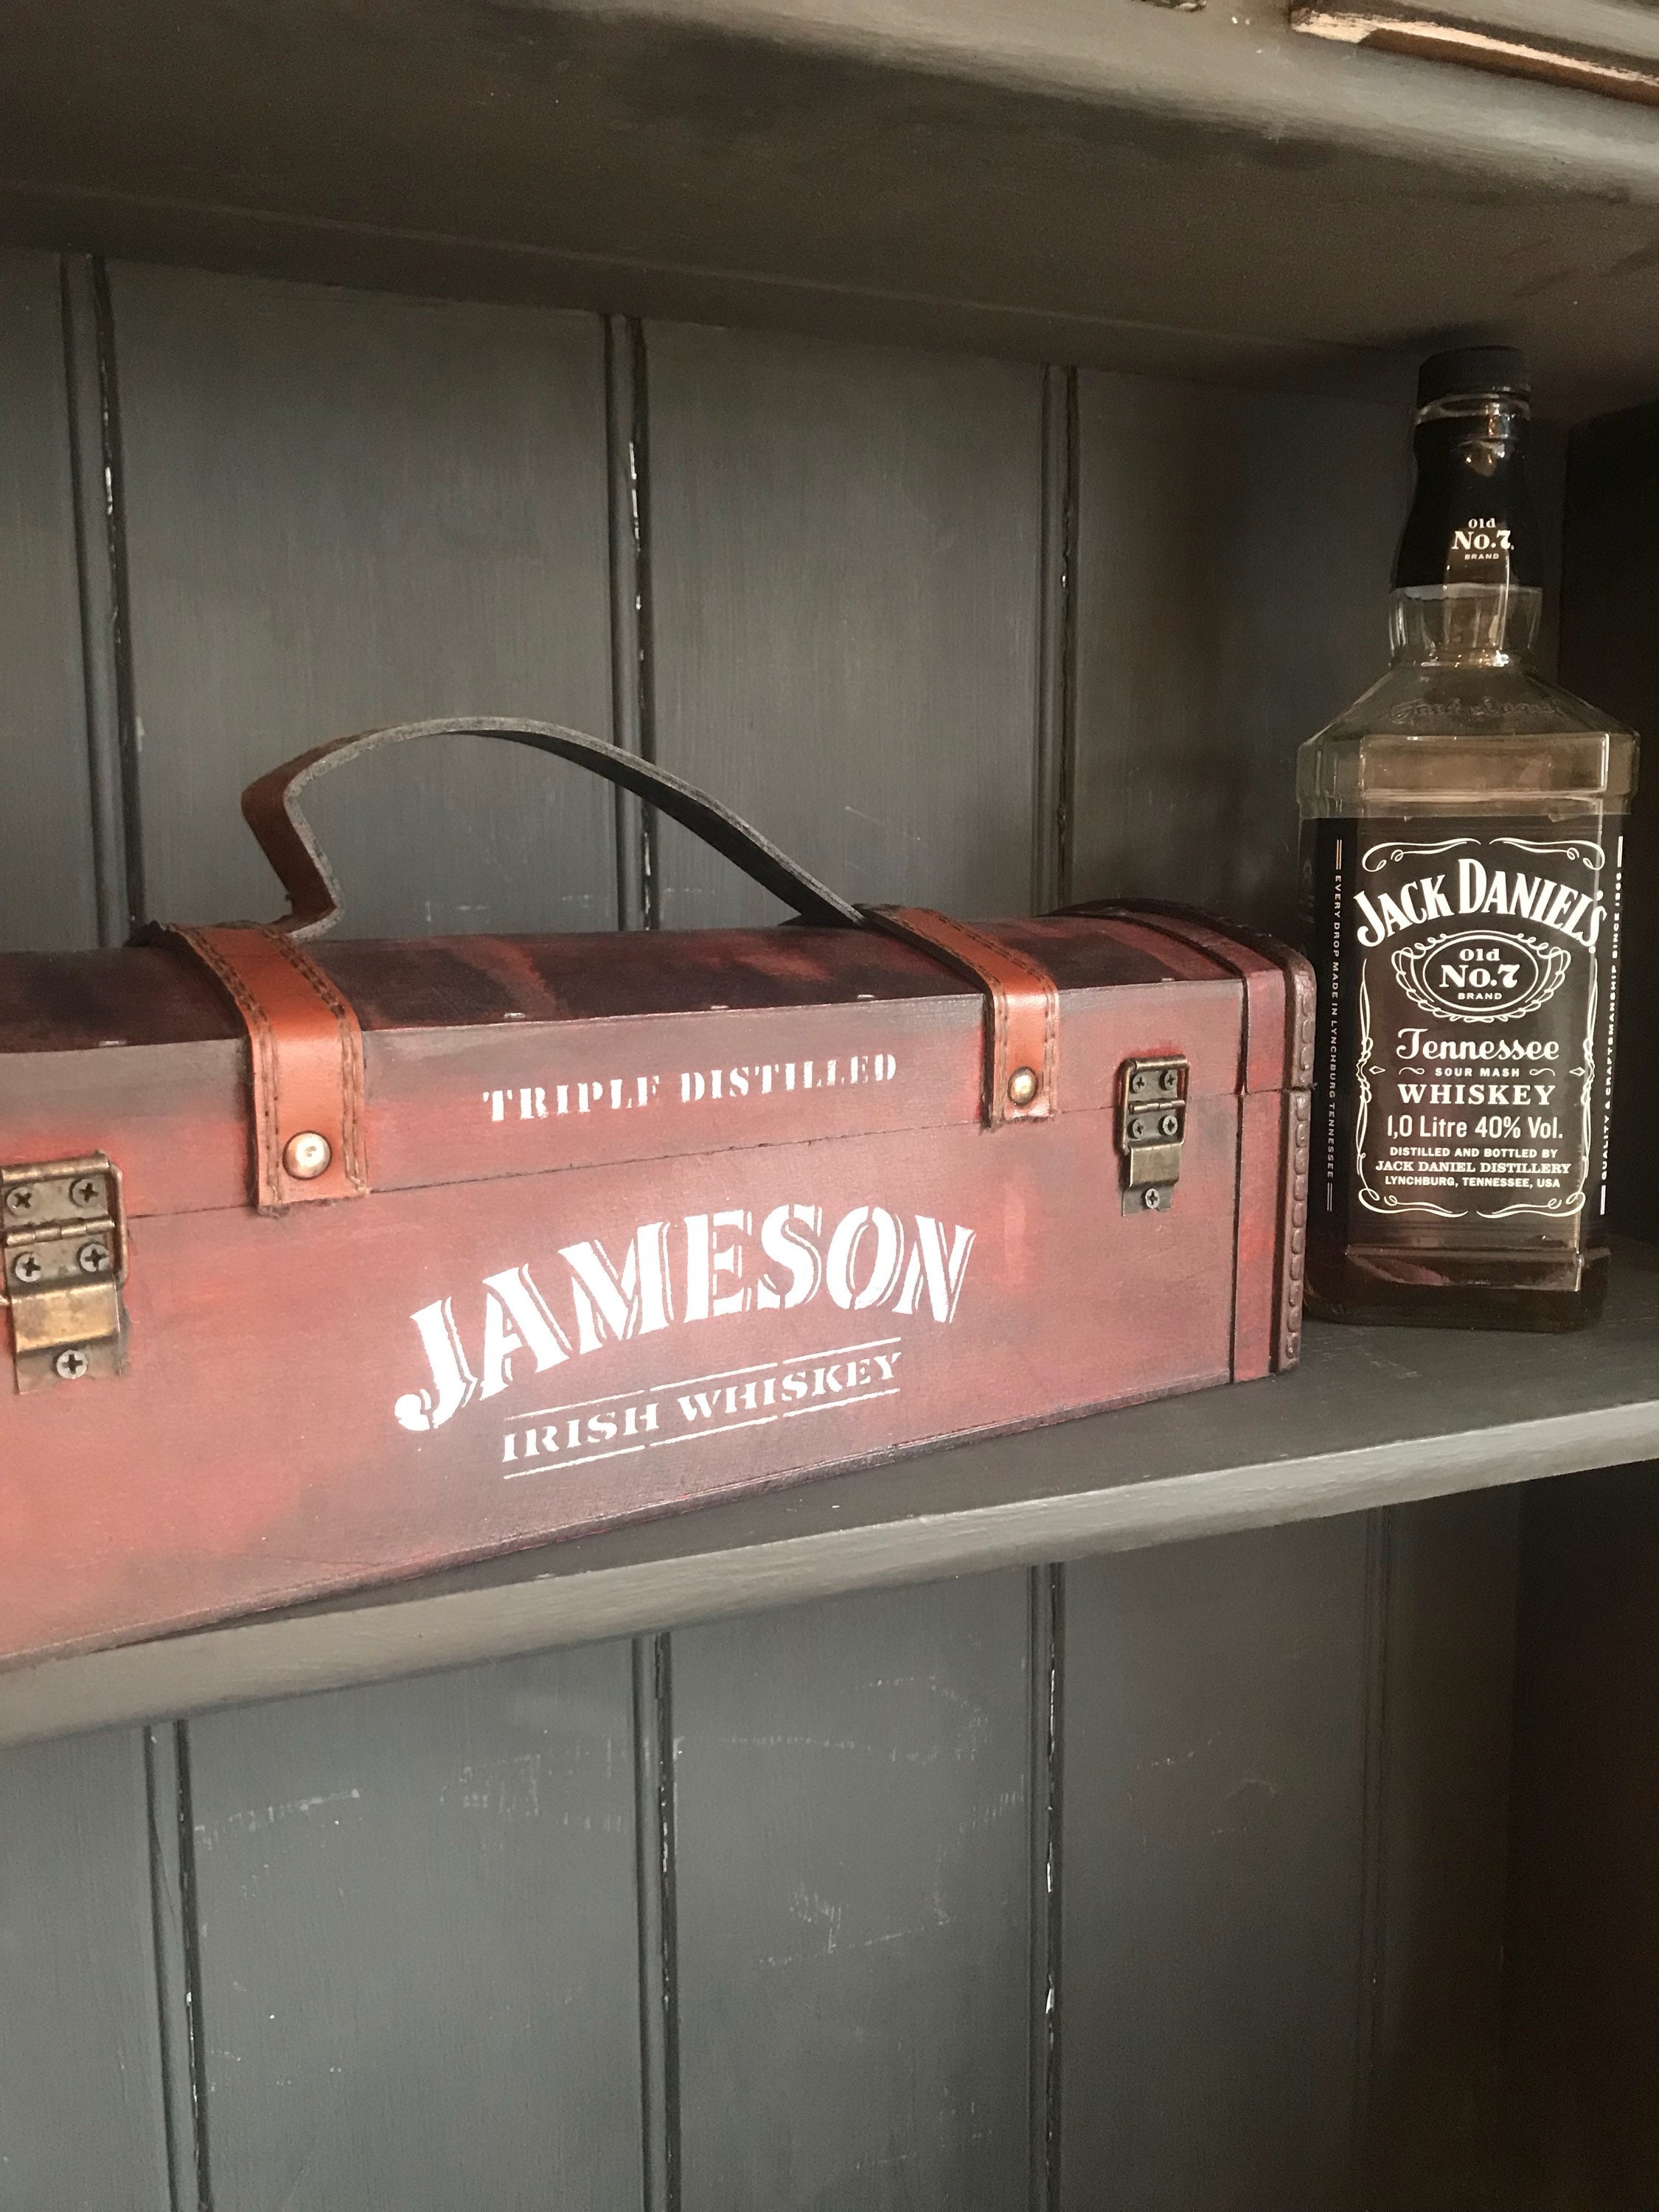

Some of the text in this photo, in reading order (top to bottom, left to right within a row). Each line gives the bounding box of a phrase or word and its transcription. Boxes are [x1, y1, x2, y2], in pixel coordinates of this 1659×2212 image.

[1468, 518, 1496, 529] Old
[1334, 875, 1342, 918] EVERY
[1354, 874, 1454, 947] JACK
[1458, 858, 1607, 948] DANIEL'S
[1459, 948, 1500, 961] Old
[1612, 913, 1620, 959] SINCE
[1332, 1003, 1338, 1015] IN
[1396, 1028, 1559, 1060] Tennessee
[1605, 964, 1618, 1096] CRAFTSMANSHIP
[1329, 1020, 1338, 1098] LYNCHBURG
[1434, 1067, 1520, 1077] SOUR MASH
[681, 1054, 897, 1104] DISTILLED
[1397, 1083, 1557, 1105] WHISKEY
[1327, 1102, 1335, 1178] TENNESSEE
[1419, 1115, 1467, 1138] Litre
[1475, 1116, 1521, 1139] 40%
[1527, 1116, 1563, 1139] Vol.
[1390, 1147, 1558, 1158] DISTILLED AND BOTTLED BY
[1601, 1115, 1610, 1180] QUALITY
[1375, 1160, 1572, 1174] JACK DANIEL DISTILLERY
[1385, 1175, 1561, 1189] LYNCHBURG, TENNESSEE, USA
[394, 1203, 976, 1432] JAMESON
[501, 1352, 902, 1462] IRISH WHISKEY
